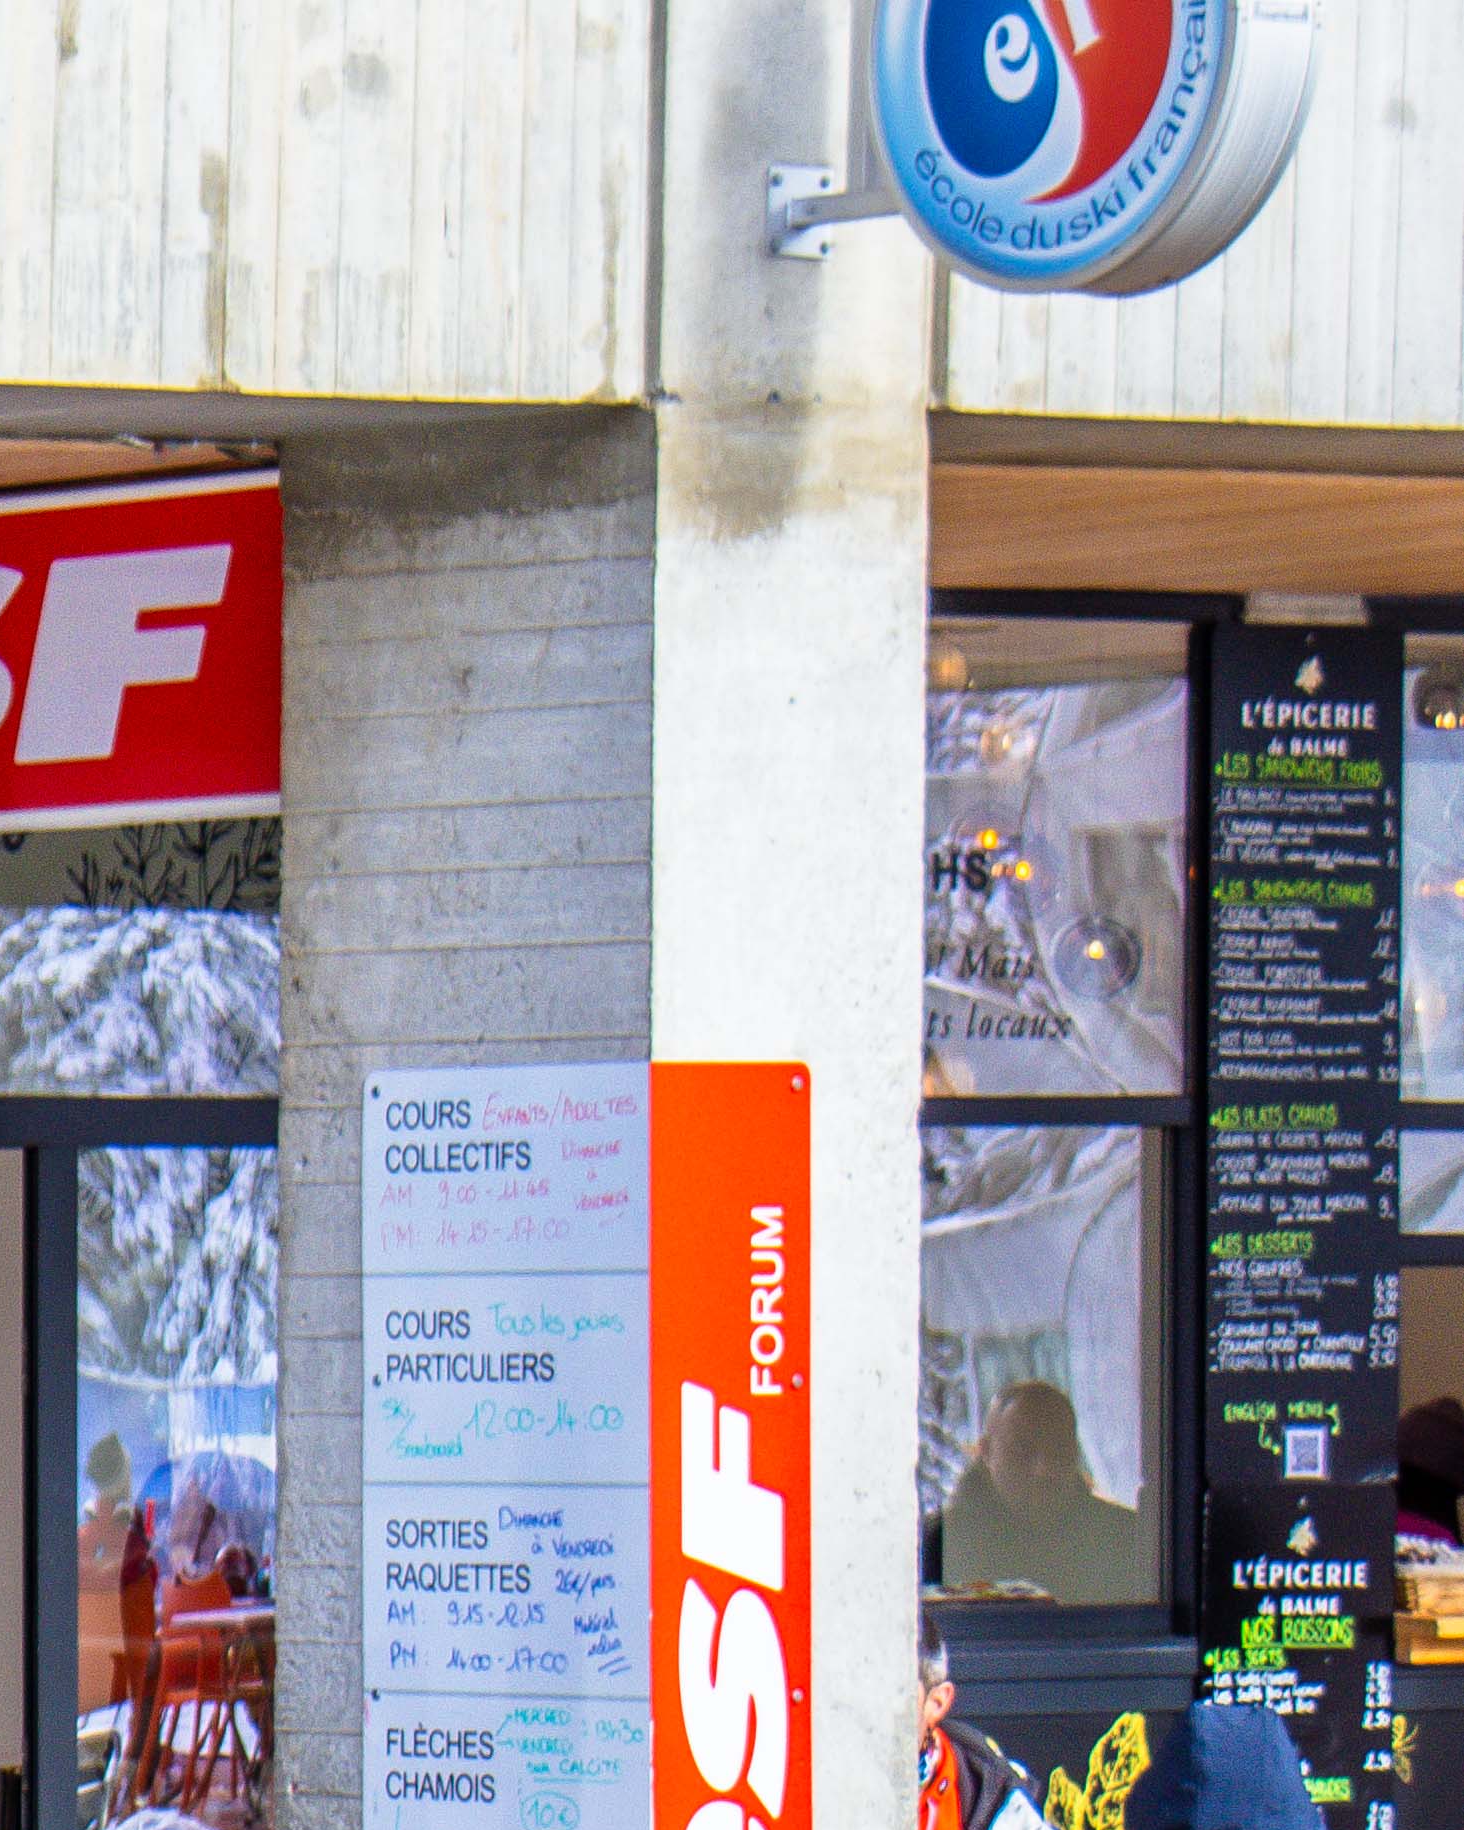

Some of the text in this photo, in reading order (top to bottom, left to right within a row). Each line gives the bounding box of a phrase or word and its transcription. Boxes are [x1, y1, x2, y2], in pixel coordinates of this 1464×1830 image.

[915, 148, 1003, 243] école
[1241, 697, 1376, 731] L'ÉPICERIE
[386, 1100, 472, 1131] COURS
[385, 1141, 532, 1173] COLLECTIFS
[750, 1205, 785, 1397] FORUM
[386, 1310, 472, 1340] COURS
[386, 1353, 555, 1383] PARTICULIERS
[386, 1519, 489, 1549] SORTIES
[386, 1563, 532, 1594] RAQUETTES
[1232, 1553, 1369, 1589] L'ÉPICERIE
[1281, 1594, 1341, 1616] BALME
[1241, 1615, 1355, 1648] NOS BOISSONS
[386, 1722, 495, 1761] FLÈCHES
[385, 1770, 496, 1804] CHAMOIS
